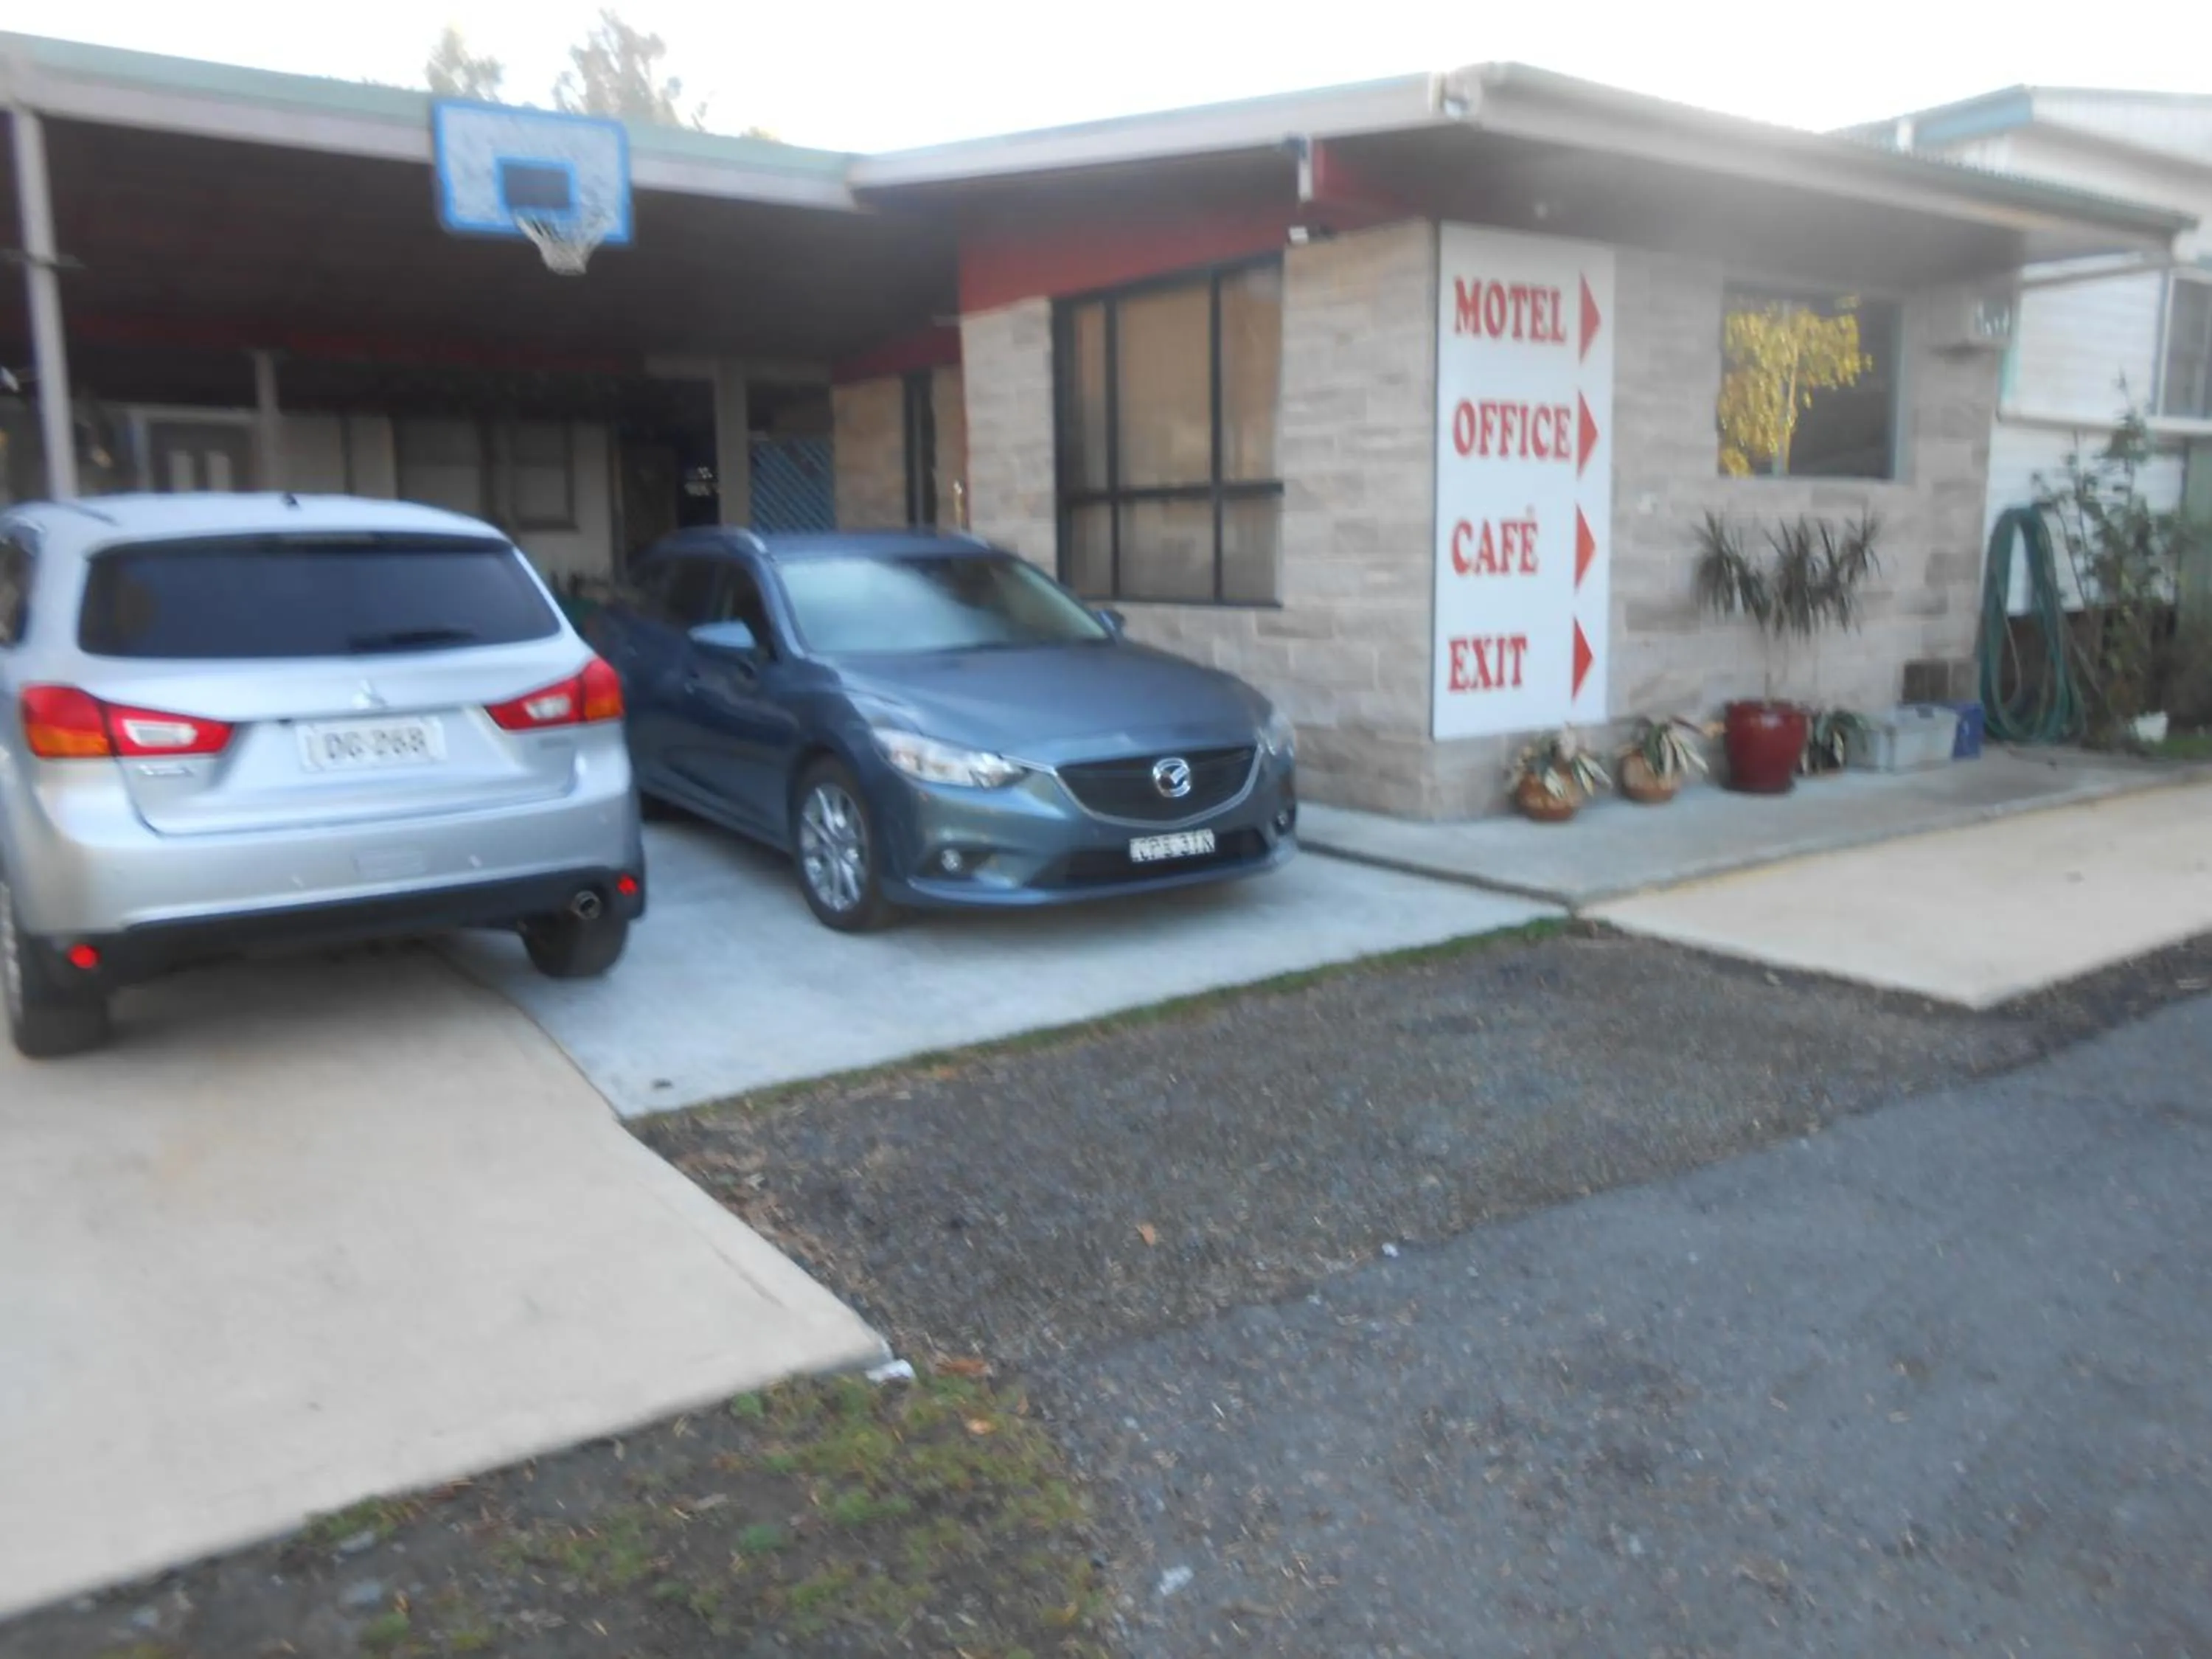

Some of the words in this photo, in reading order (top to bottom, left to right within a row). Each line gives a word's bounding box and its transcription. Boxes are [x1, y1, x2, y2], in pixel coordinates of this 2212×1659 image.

[1455, 277, 1567, 344] MOTEL
[1453, 400, 1568, 459] OFFICE
[1453, 509, 1537, 576] CAFÉ
[1450, 636, 1528, 692] EXIT
